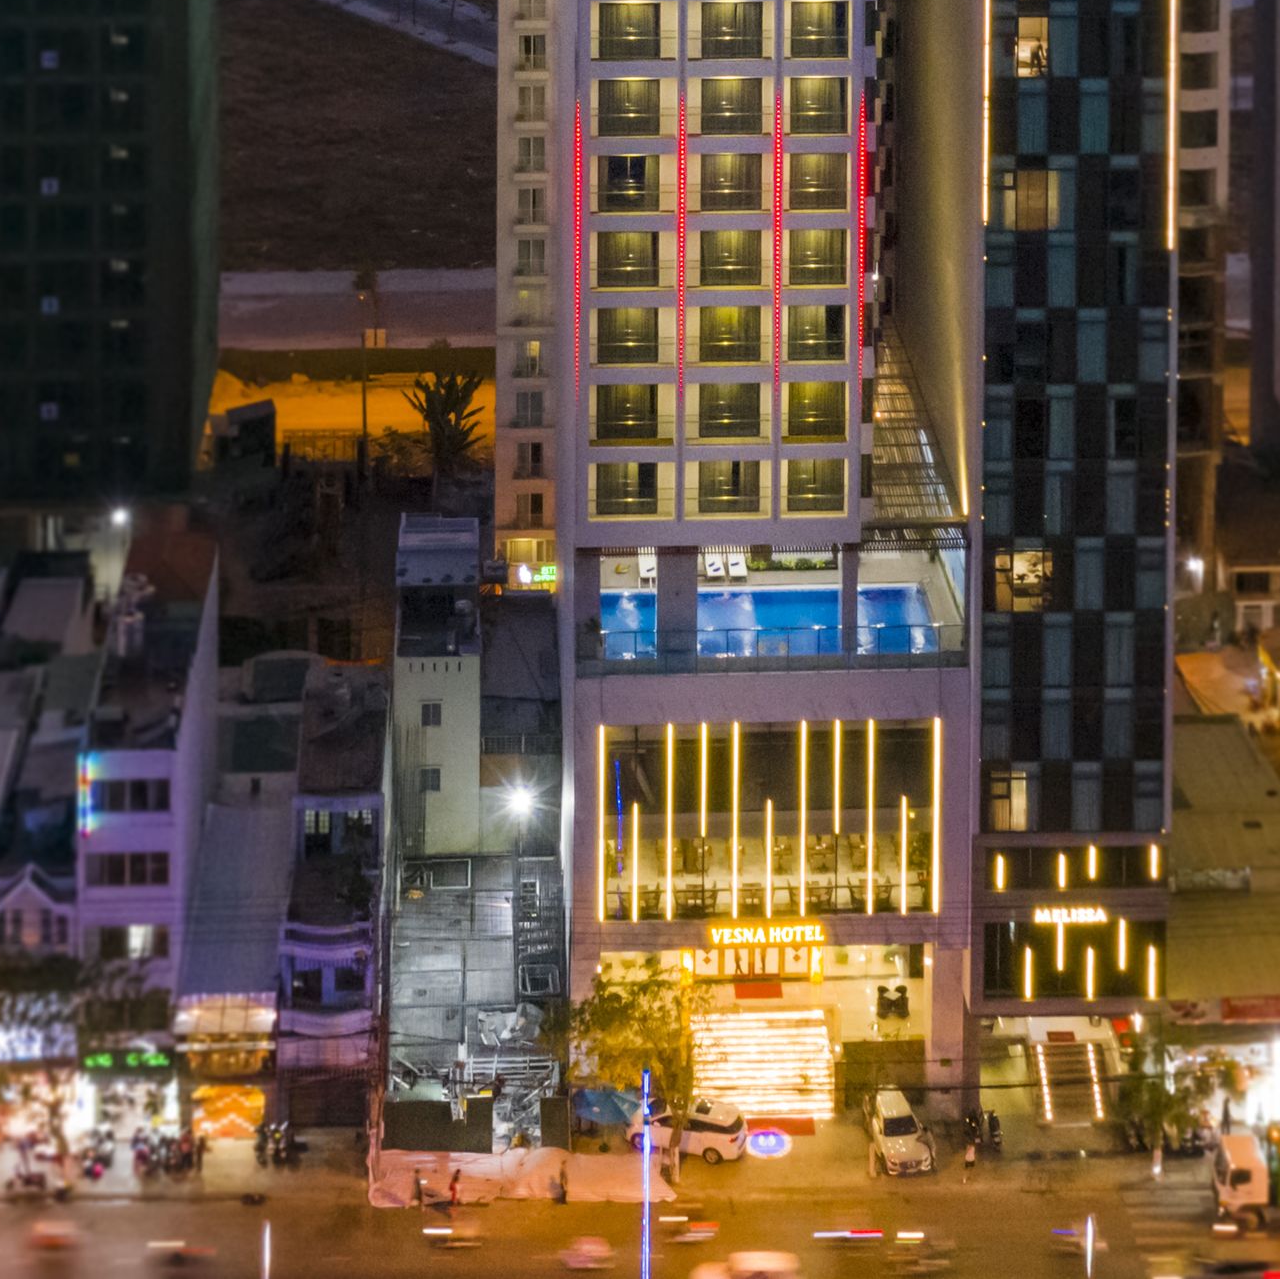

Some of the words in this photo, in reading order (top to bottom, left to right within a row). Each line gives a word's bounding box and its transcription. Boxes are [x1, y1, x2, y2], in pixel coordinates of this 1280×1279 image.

[1034, 907, 1108, 923] MELISSA
[711, 927, 767, 944] VESNA
[769, 924, 825, 942] HOTEL
